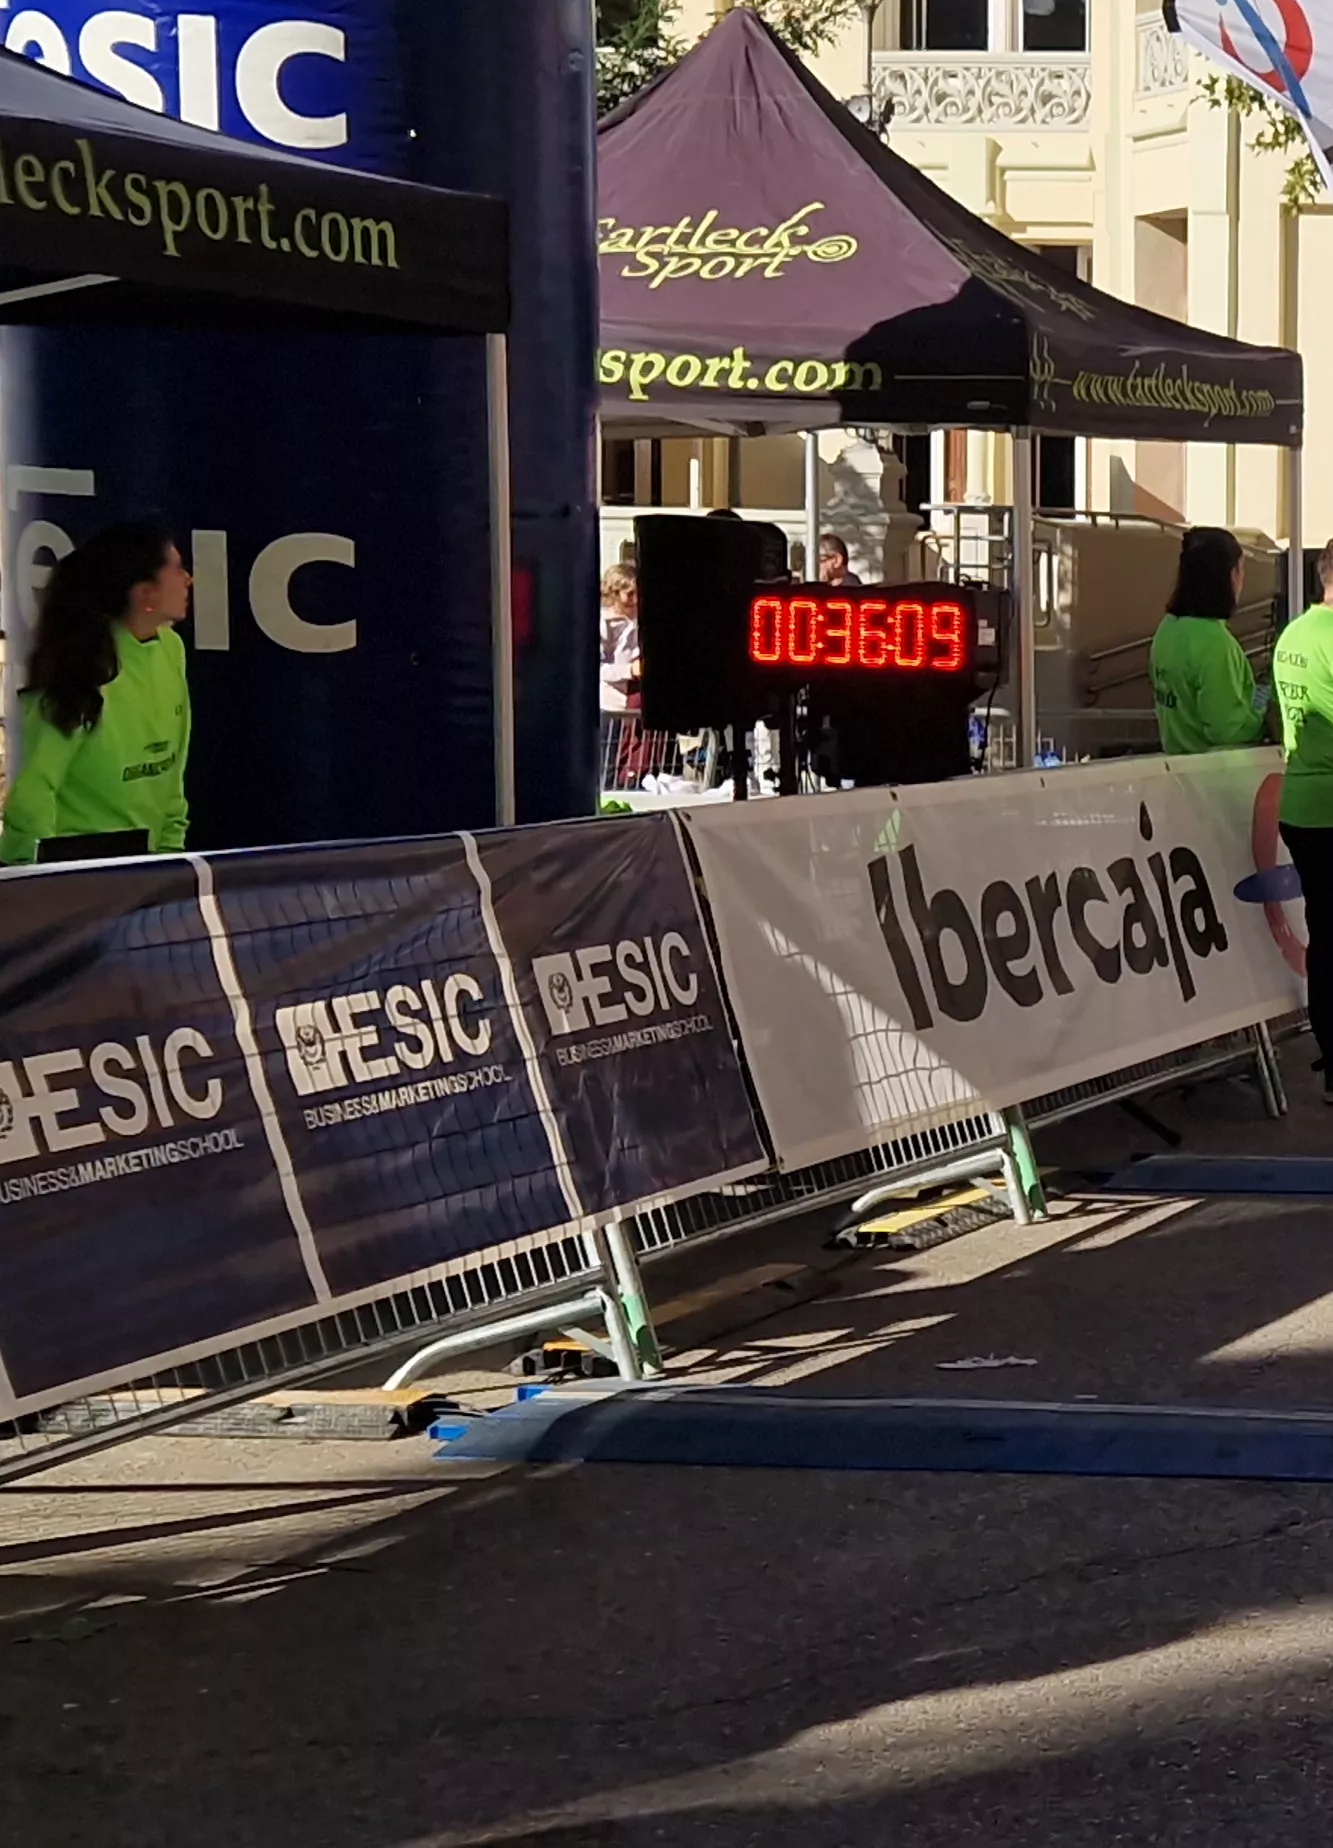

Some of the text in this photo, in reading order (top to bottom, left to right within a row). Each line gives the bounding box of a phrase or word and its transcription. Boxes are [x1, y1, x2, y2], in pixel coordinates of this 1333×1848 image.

[620, 244, 793, 289] Sport
[752, 597, 962, 669] 00:36:09
[867, 800, 1229, 1032] Ibercaja
[330, 973, 492, 1083] ESIC
[575, 932, 698, 1026] ESIC
[23, 1027, 223, 1152] ESIC
